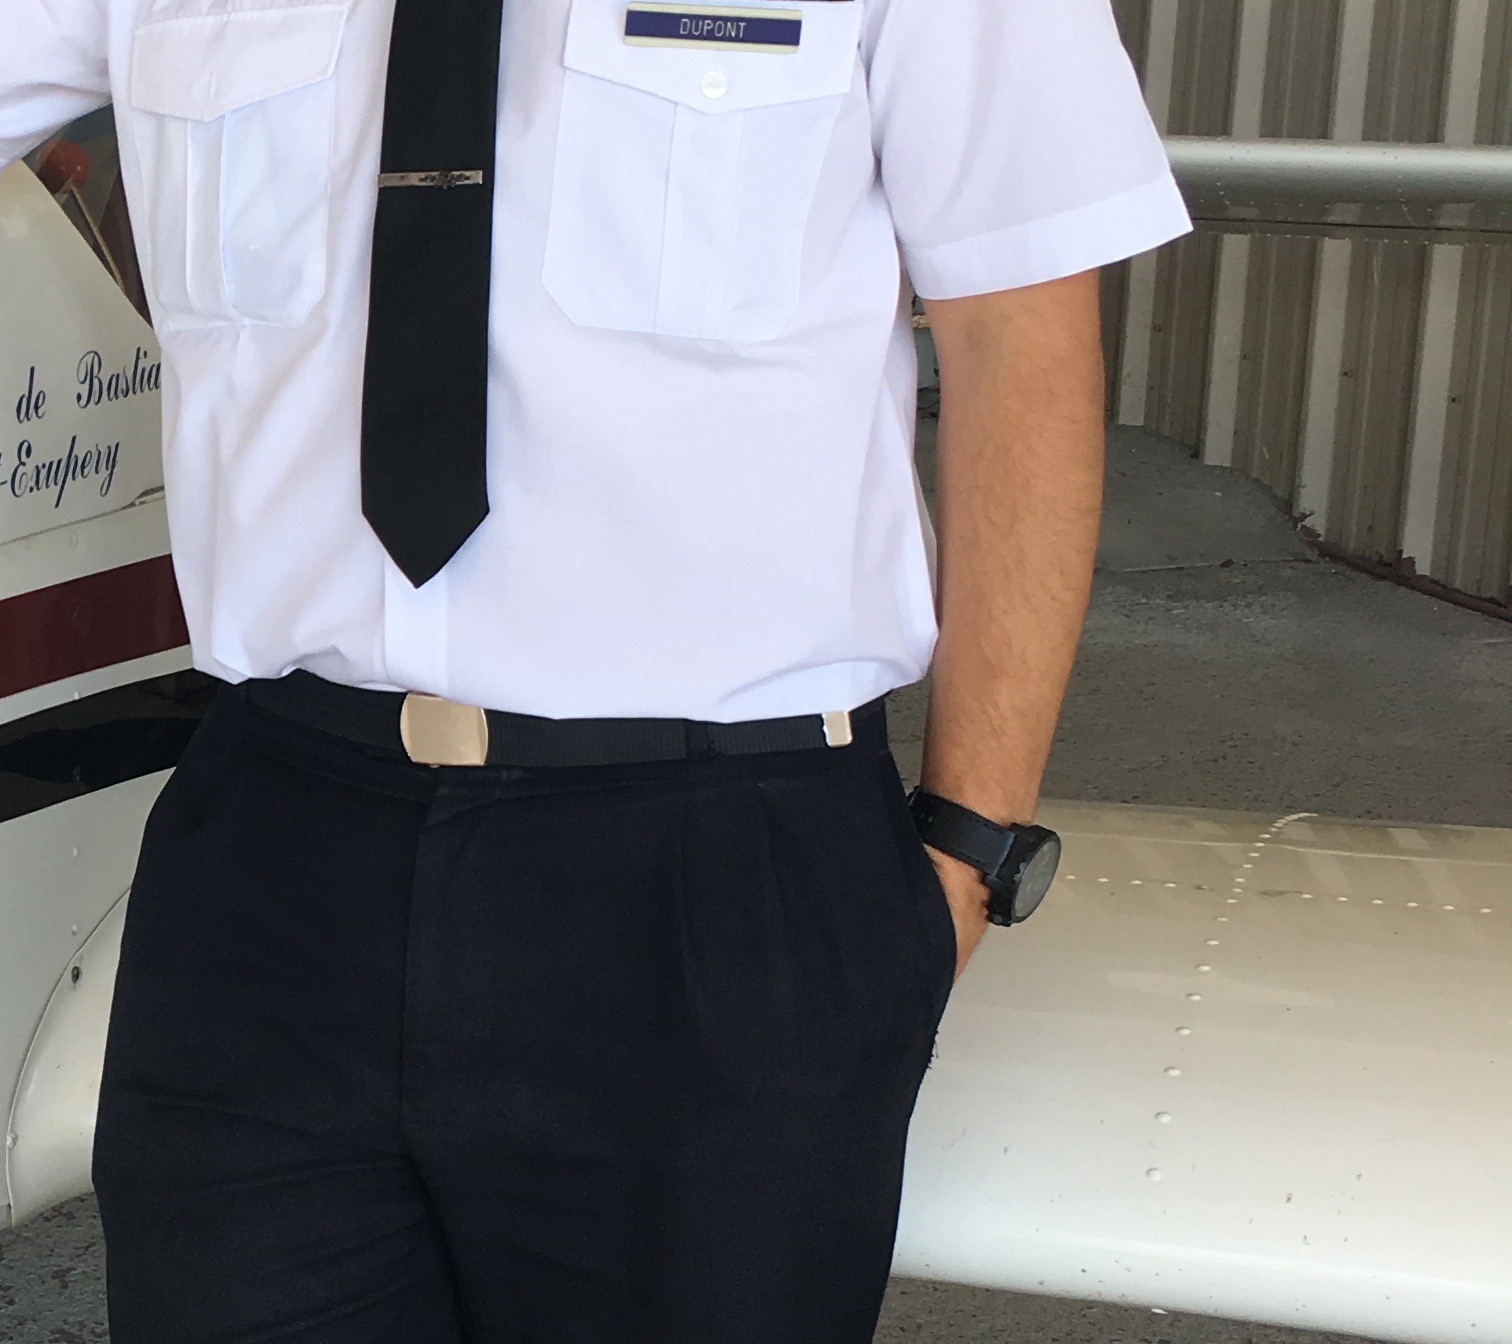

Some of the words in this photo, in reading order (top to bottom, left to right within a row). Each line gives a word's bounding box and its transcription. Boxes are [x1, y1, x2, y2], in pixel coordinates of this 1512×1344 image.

[680, 18, 747, 39] DUPONT
[16, 366, 46, 424] de
[76, 346, 161, 409] Bastia
